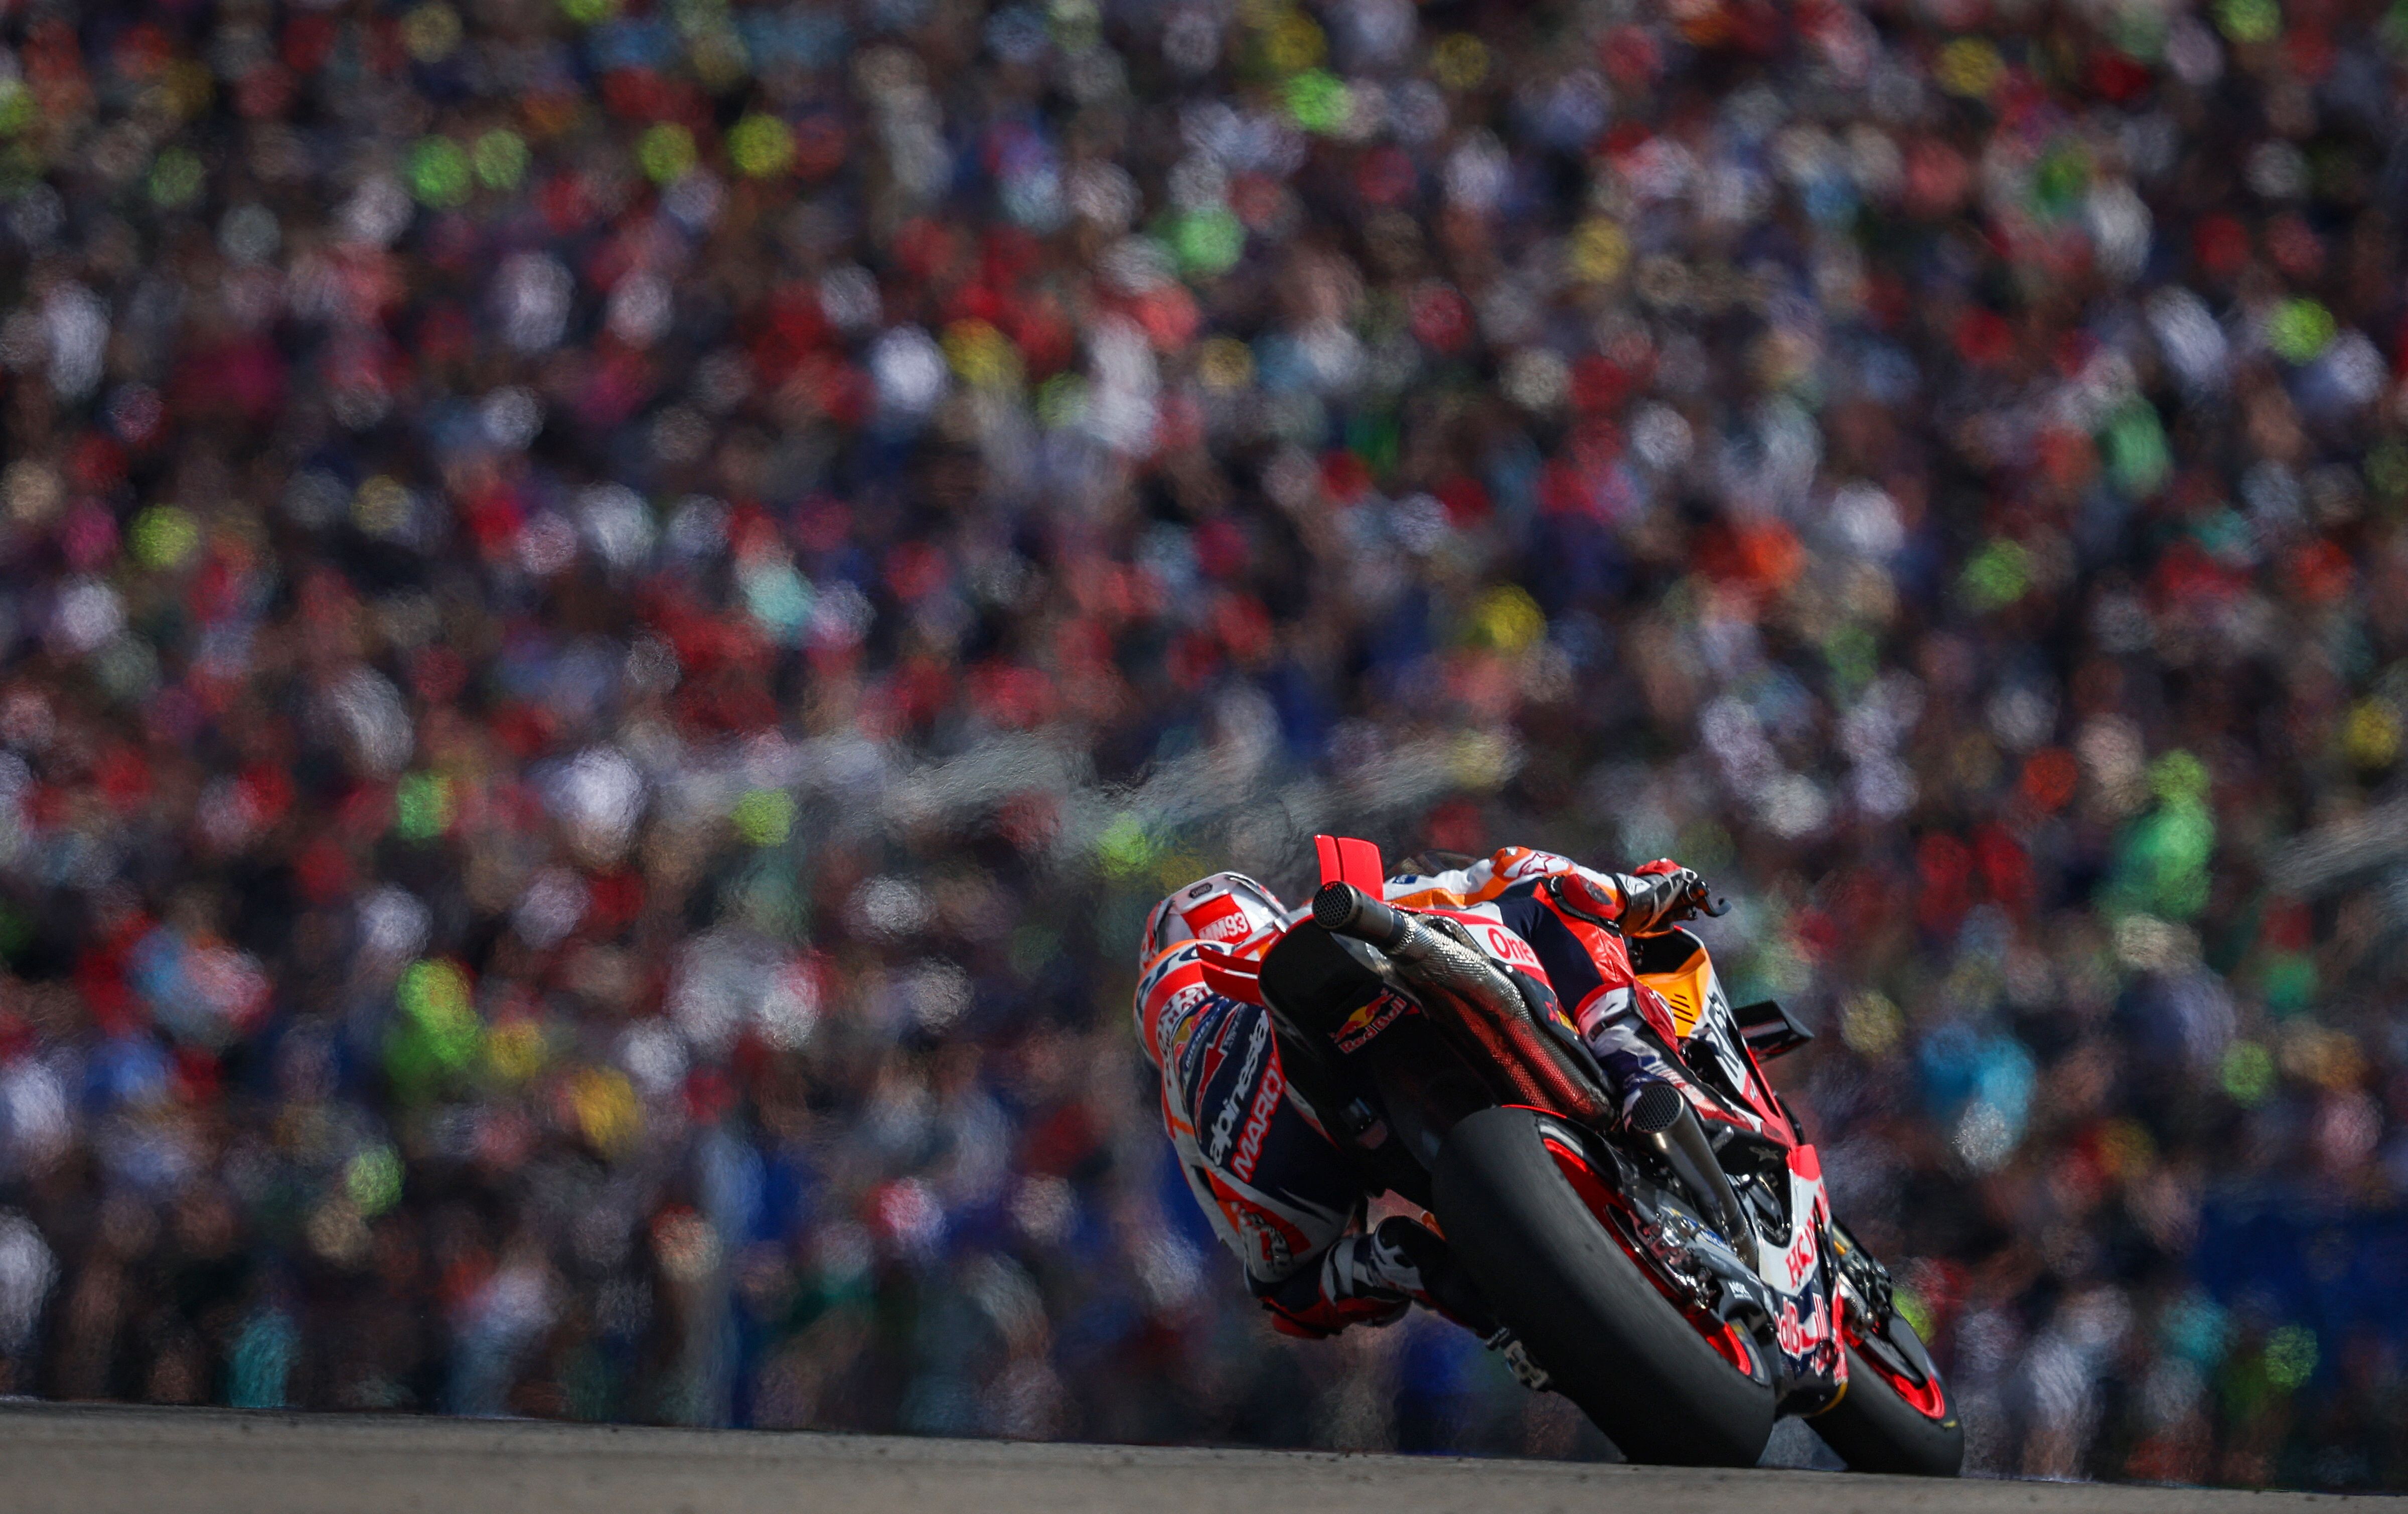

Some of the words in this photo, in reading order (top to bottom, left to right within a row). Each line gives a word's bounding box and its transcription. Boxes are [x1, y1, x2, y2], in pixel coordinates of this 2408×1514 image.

[1198, 912, 1248, 940] MM93
[1487, 928, 1534, 963] One
[1338, 1025, 1379, 1054] Red
[1372, 996, 1407, 1031] Bull
